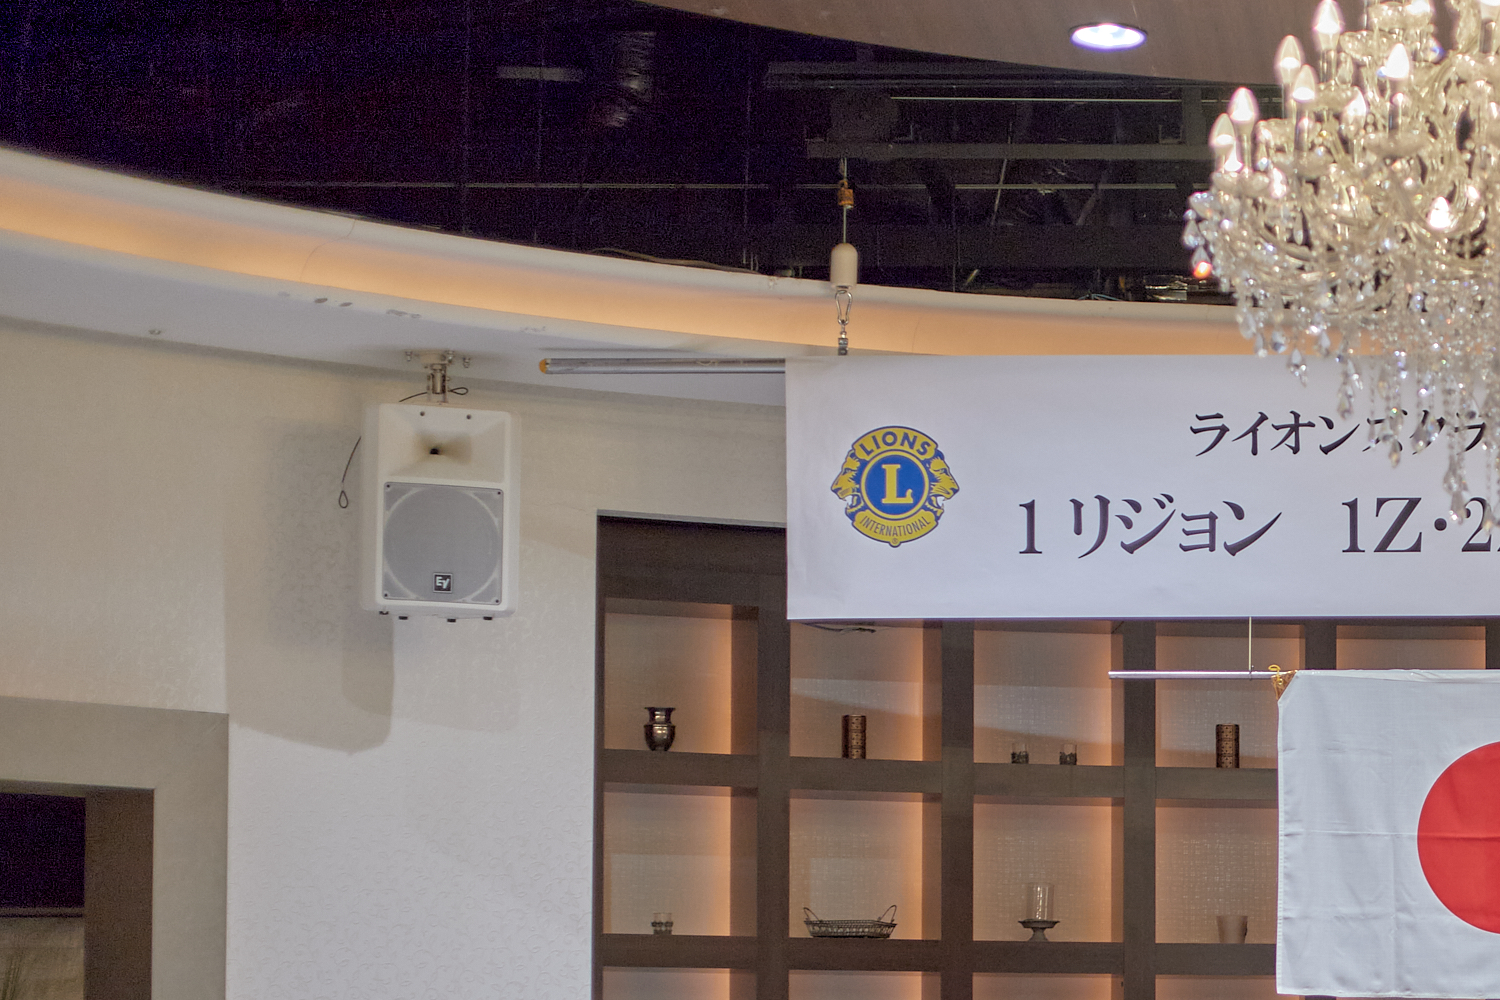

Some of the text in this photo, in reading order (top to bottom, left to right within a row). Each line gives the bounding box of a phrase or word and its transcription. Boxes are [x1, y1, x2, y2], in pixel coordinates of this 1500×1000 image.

[859, 431, 931, 457] LIONS
[882, 464, 914, 504] L
[859, 515, 931, 537] INTERNATIONAL
